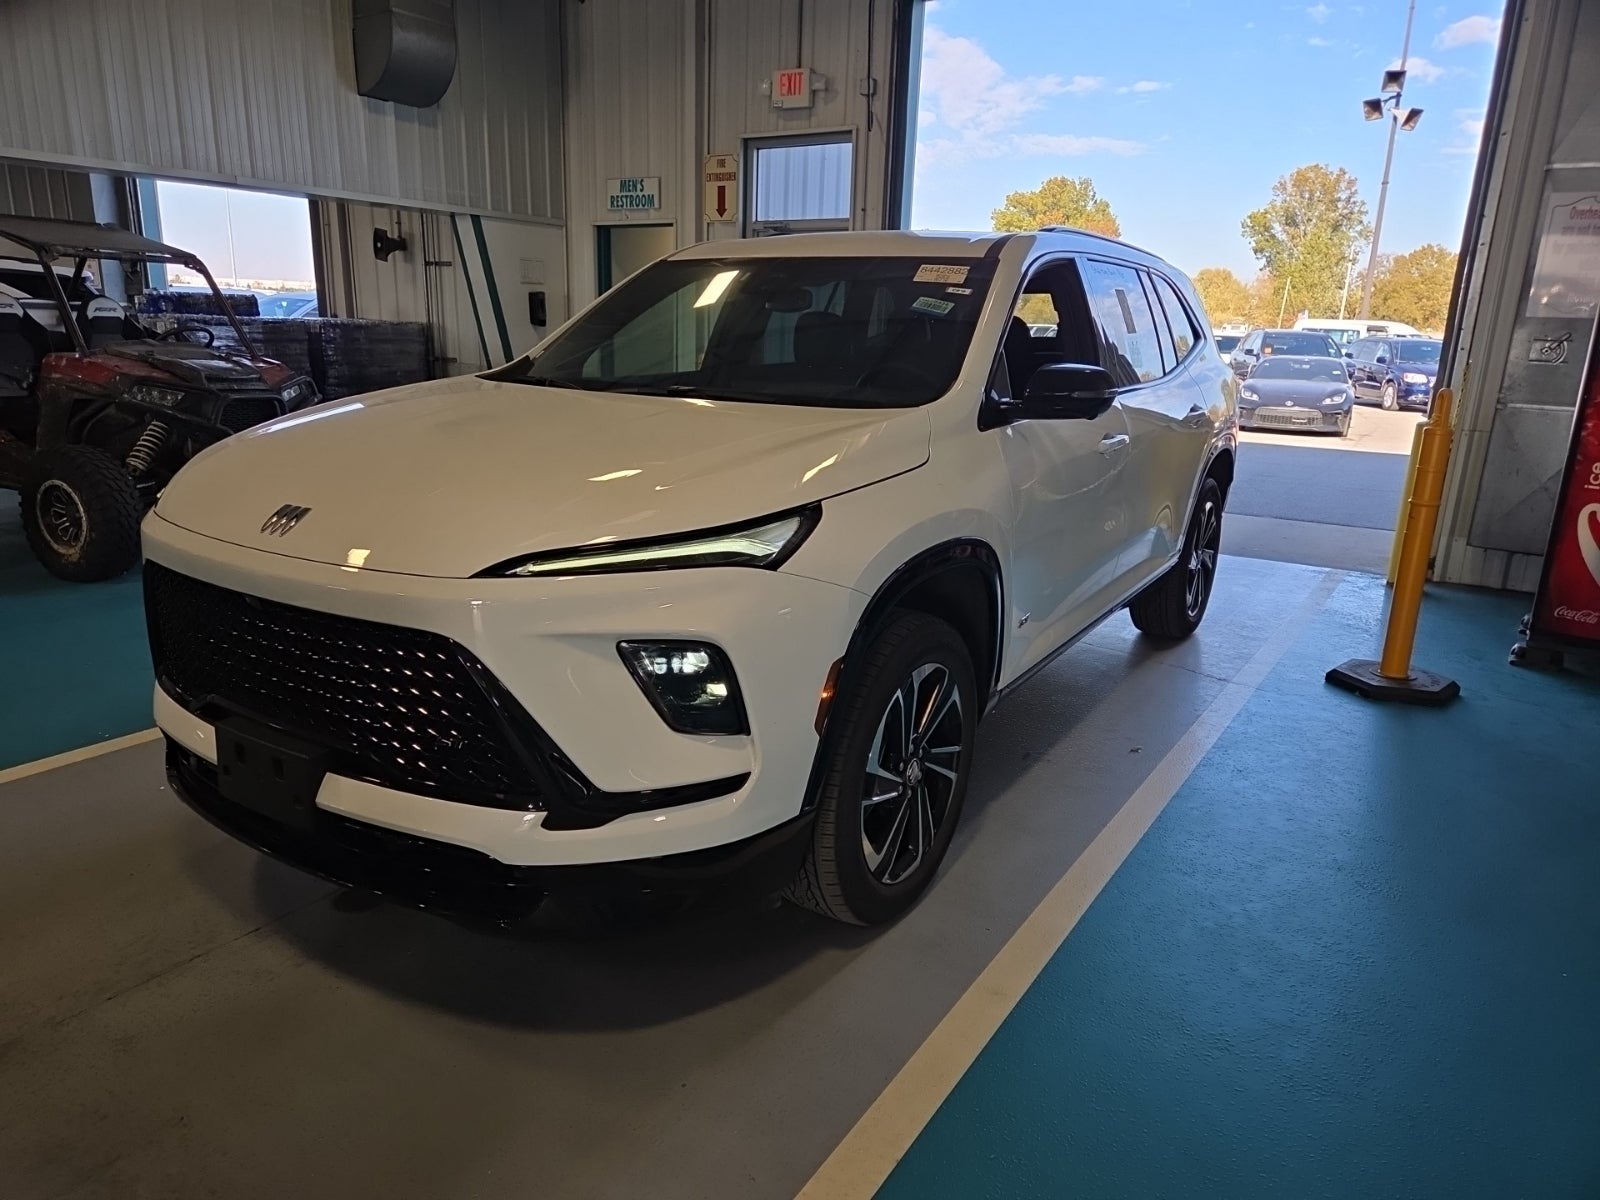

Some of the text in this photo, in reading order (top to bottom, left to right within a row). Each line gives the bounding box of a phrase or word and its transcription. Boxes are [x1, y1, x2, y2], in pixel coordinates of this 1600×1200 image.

[781, 72, 804, 97] EXIT
[619, 178, 645, 193] MEN'S
[610, 193, 655, 209] RESTROOM
